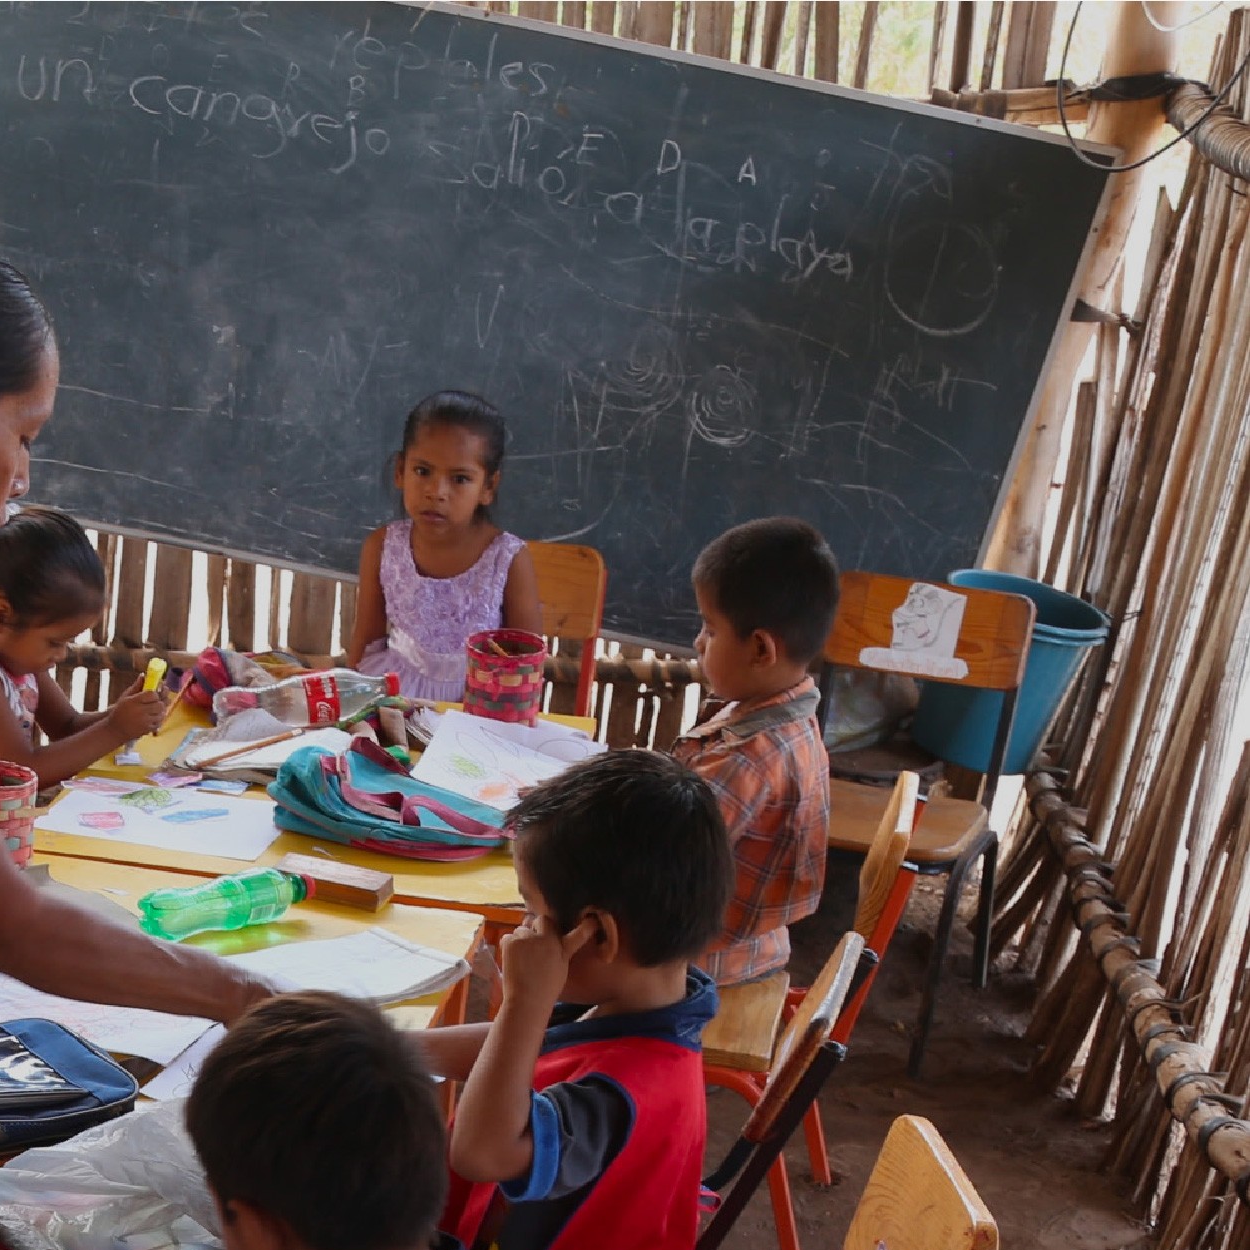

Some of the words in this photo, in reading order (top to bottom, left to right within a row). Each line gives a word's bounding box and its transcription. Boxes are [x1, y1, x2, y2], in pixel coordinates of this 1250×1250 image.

[18, 55, 98, 104] un
[129, 75, 391, 175] cangrejo
[737, 155, 758, 186] A
